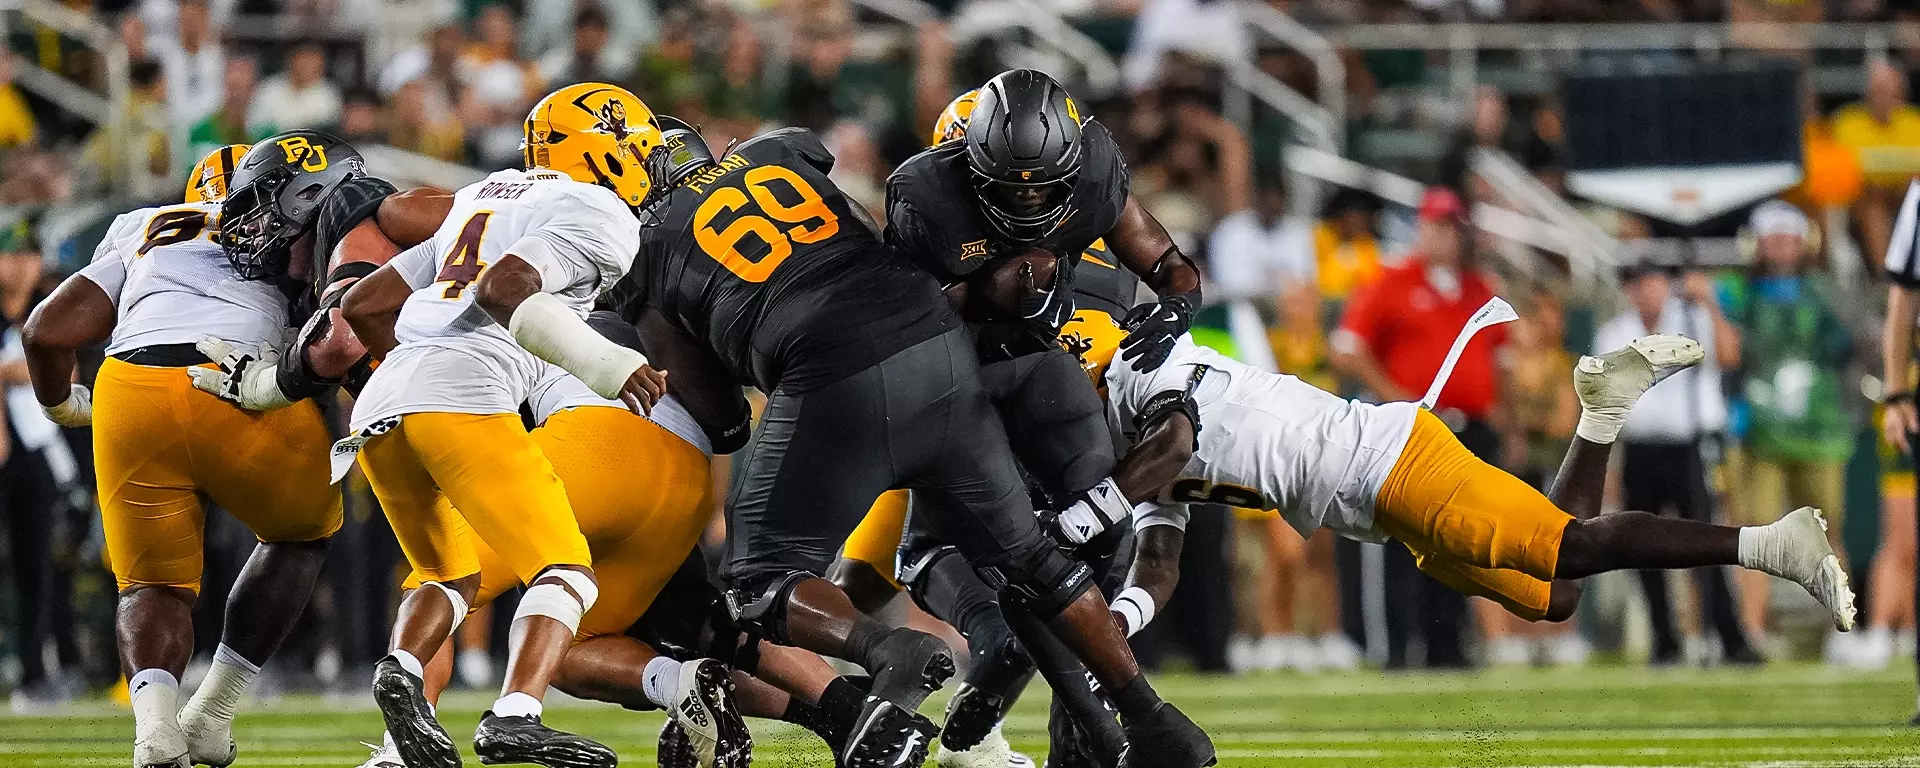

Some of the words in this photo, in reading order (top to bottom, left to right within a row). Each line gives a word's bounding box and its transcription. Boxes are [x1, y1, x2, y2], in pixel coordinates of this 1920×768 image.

[277, 136, 328, 173] BU
[436, 209, 495, 301] 4
[693, 165, 840, 283] 69
[689, 689, 709, 728] adidas
